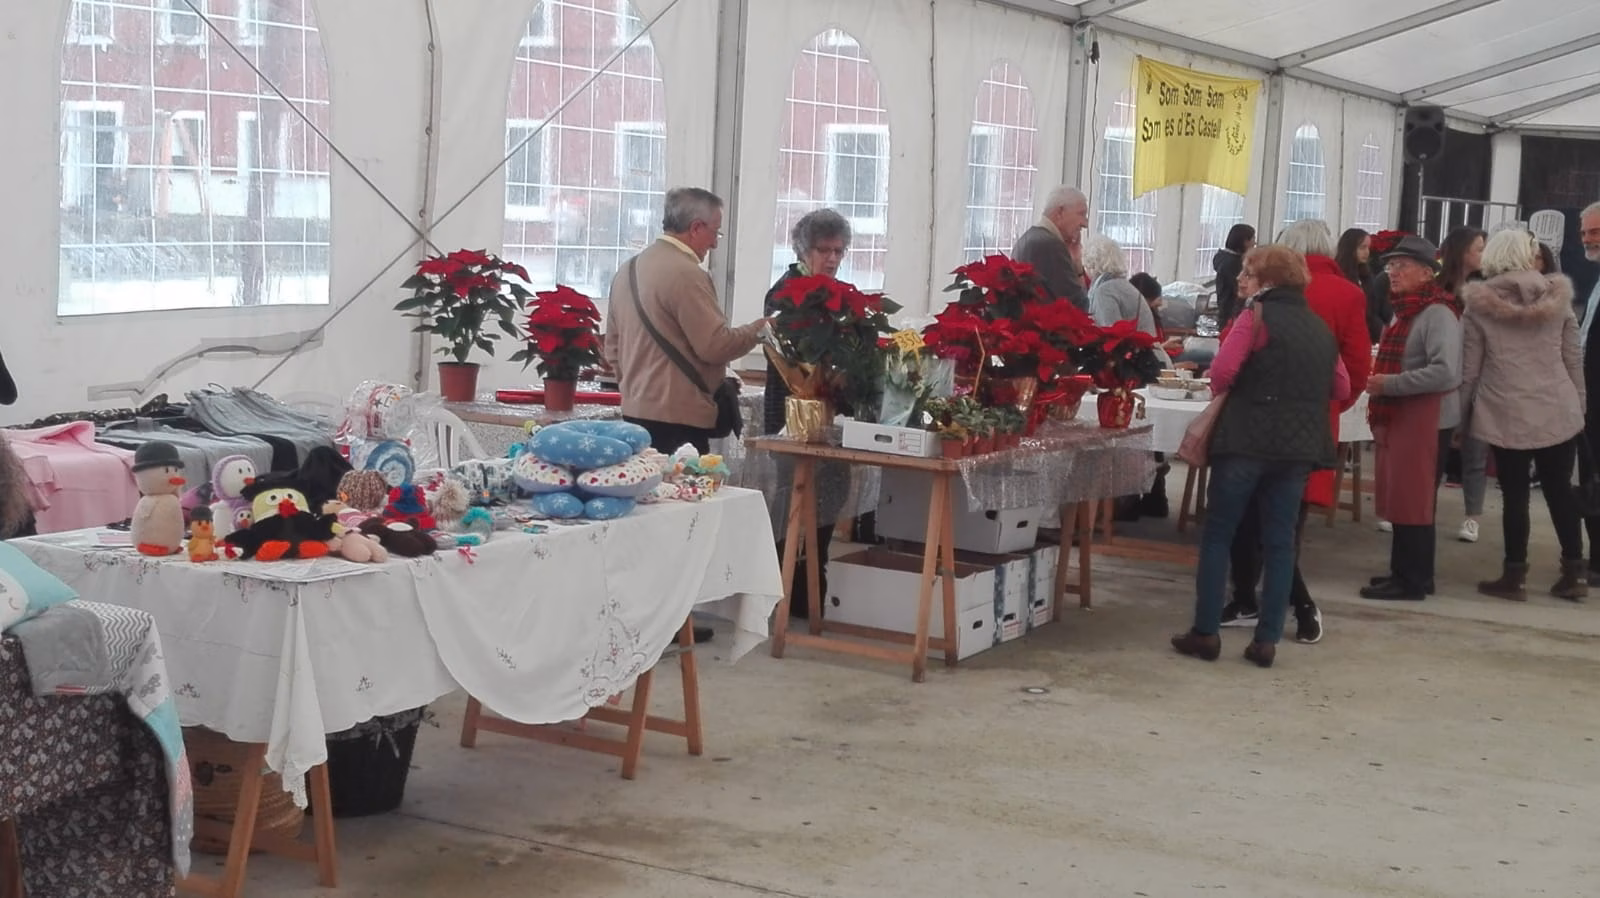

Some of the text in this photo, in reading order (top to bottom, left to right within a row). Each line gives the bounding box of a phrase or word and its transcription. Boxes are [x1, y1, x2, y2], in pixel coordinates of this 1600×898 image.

[1159, 81, 1225, 110] Som Som Som
[1142, 116, 1161, 143] Som
[1165, 118, 1174, 137] es
[1198, 114, 1222, 140] Castell
